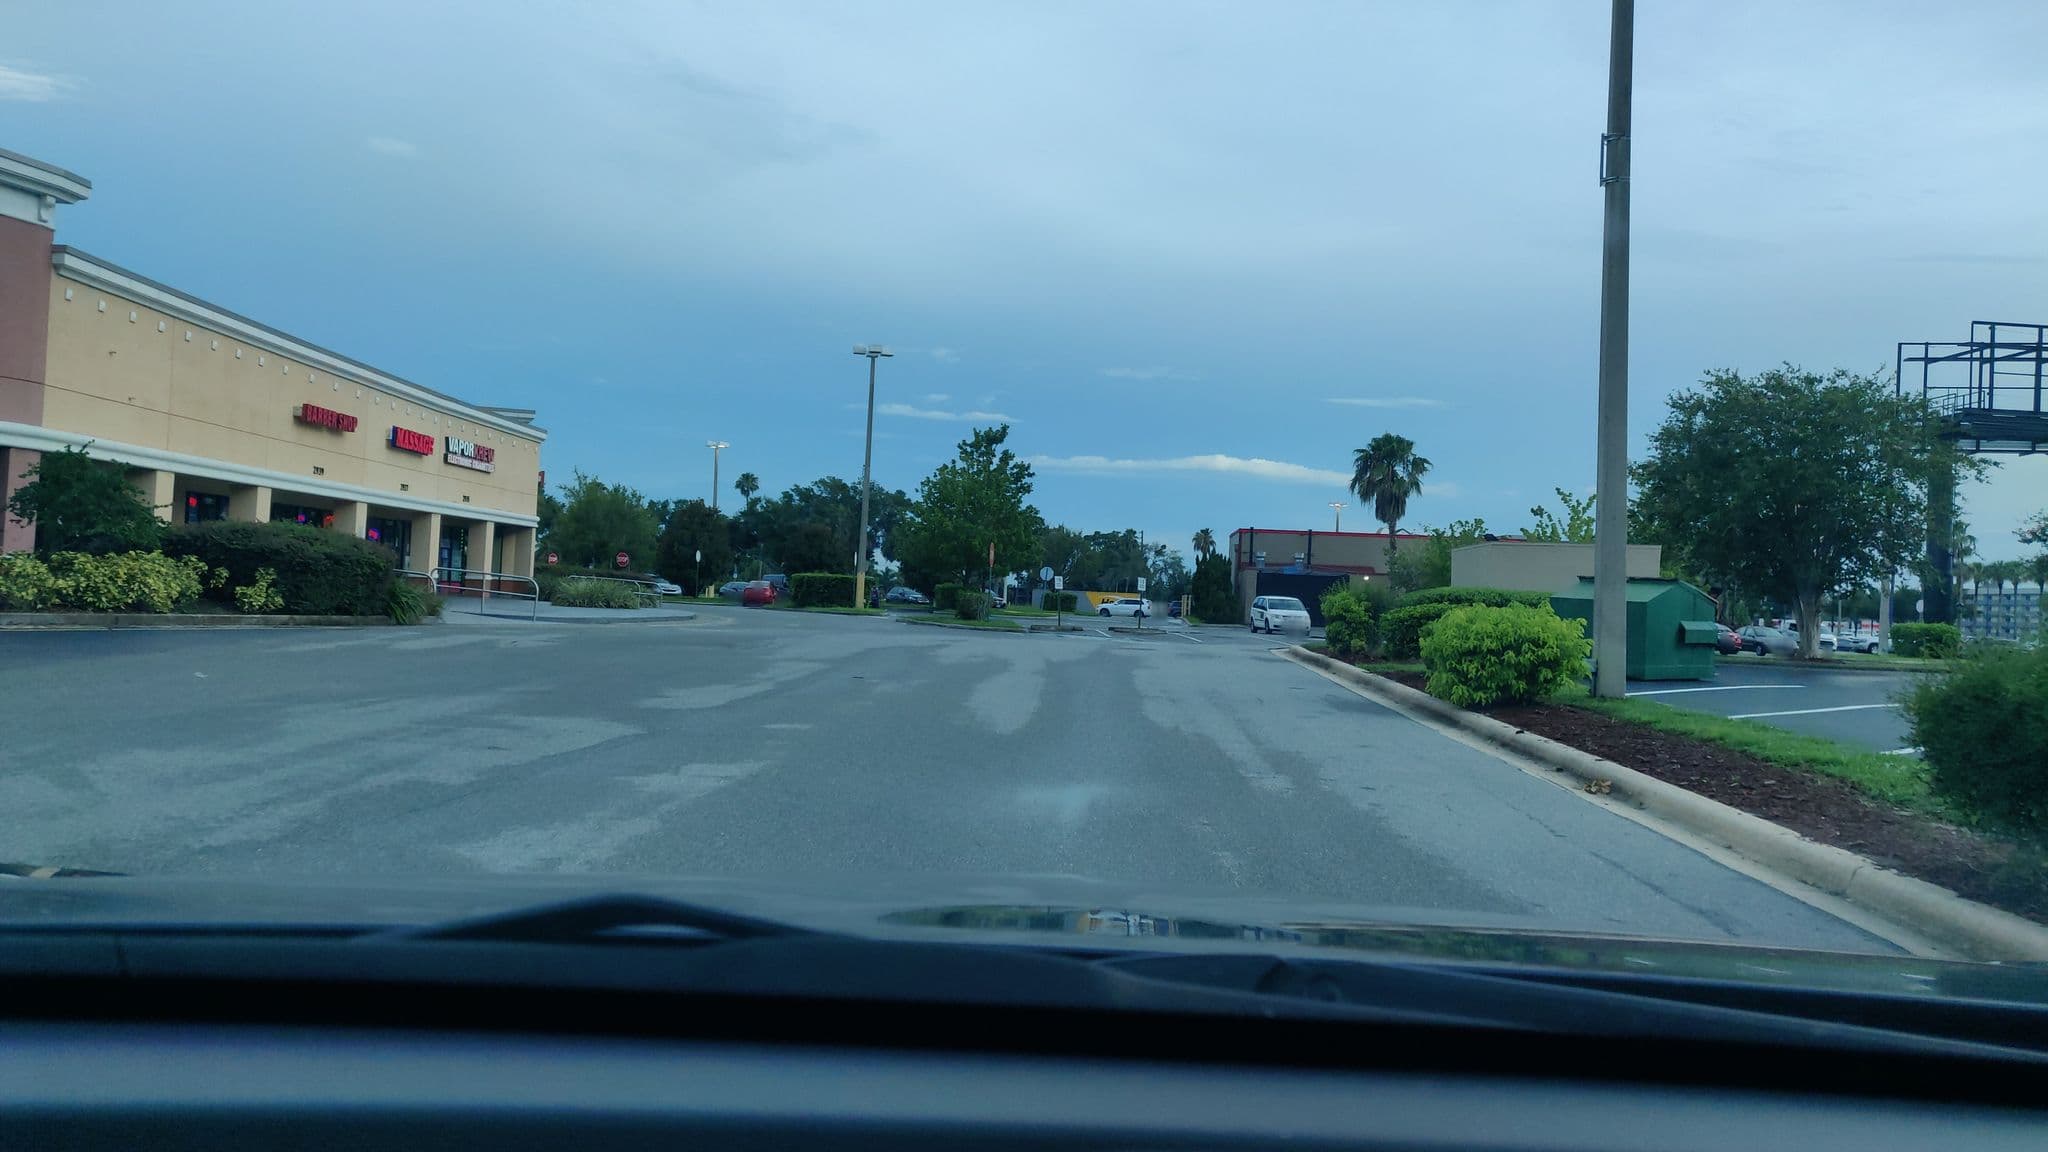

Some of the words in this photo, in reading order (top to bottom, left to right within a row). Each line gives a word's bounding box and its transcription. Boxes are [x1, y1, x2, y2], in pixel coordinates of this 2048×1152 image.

[305, 404, 337, 428] BARBER
[337, 413, 357, 432] SHOP
[396, 426, 434, 455] MASSAGE
